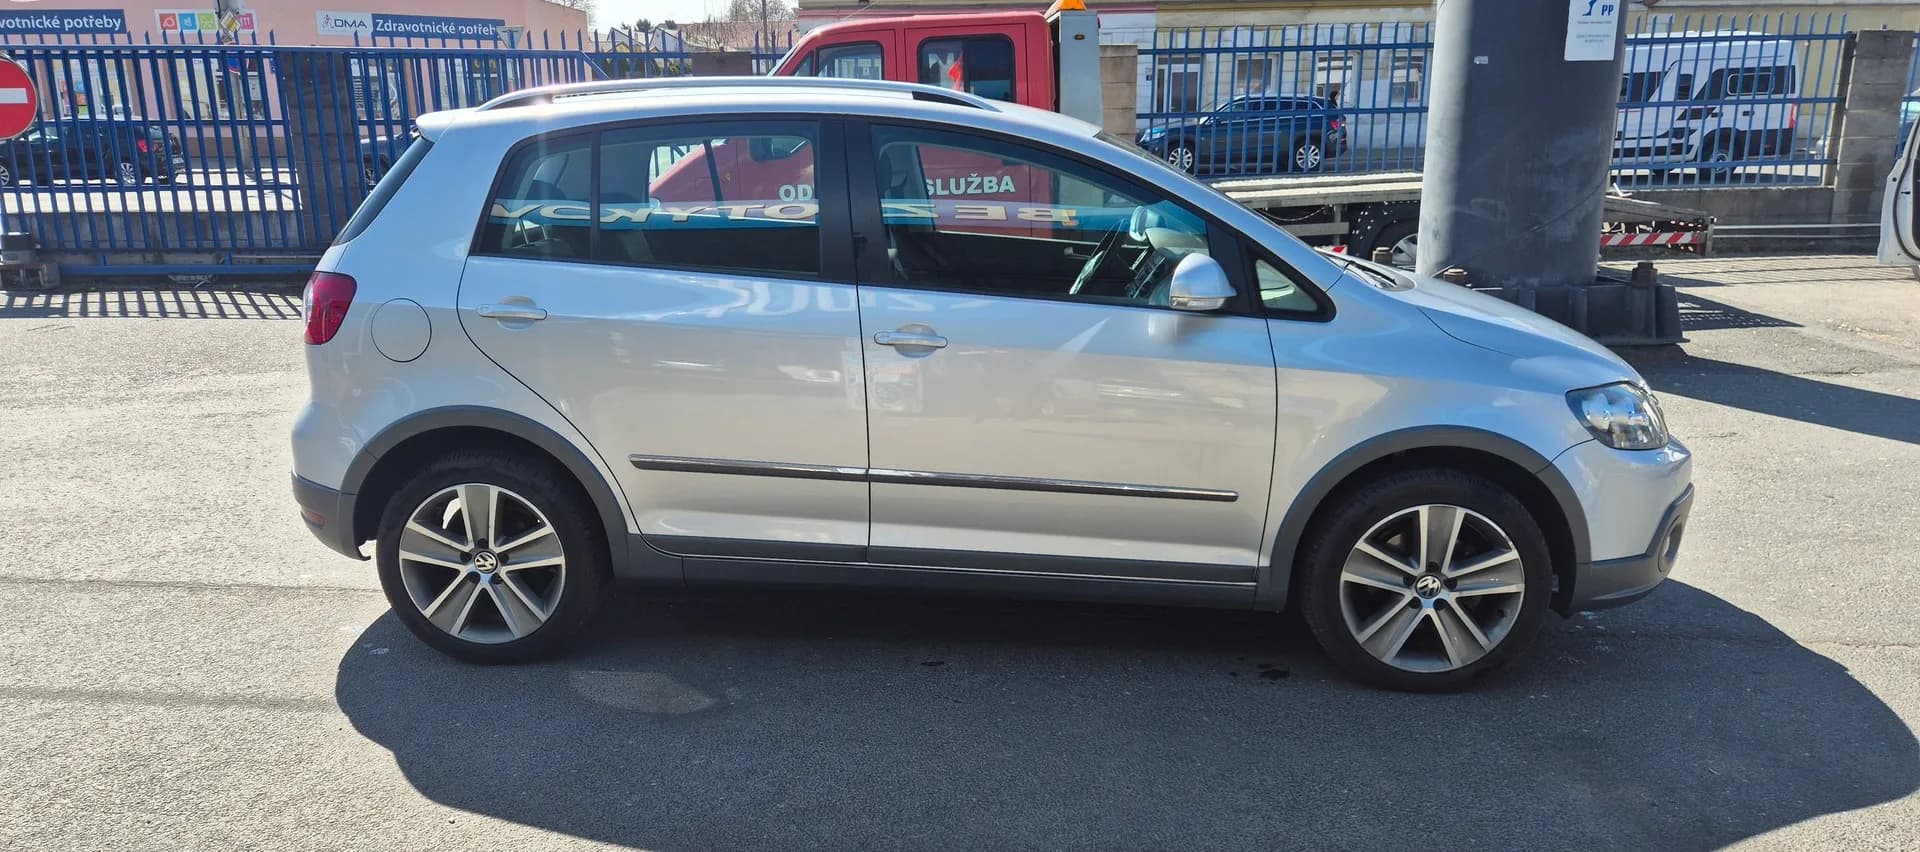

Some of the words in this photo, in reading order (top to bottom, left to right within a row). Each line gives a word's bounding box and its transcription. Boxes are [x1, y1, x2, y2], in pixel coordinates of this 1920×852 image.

[64, 16, 121, 31] potřeby
[375, 19, 456, 34] Zdravotnické
[458, 23, 503, 38] potřeb
[779, 184, 814, 202] OD
